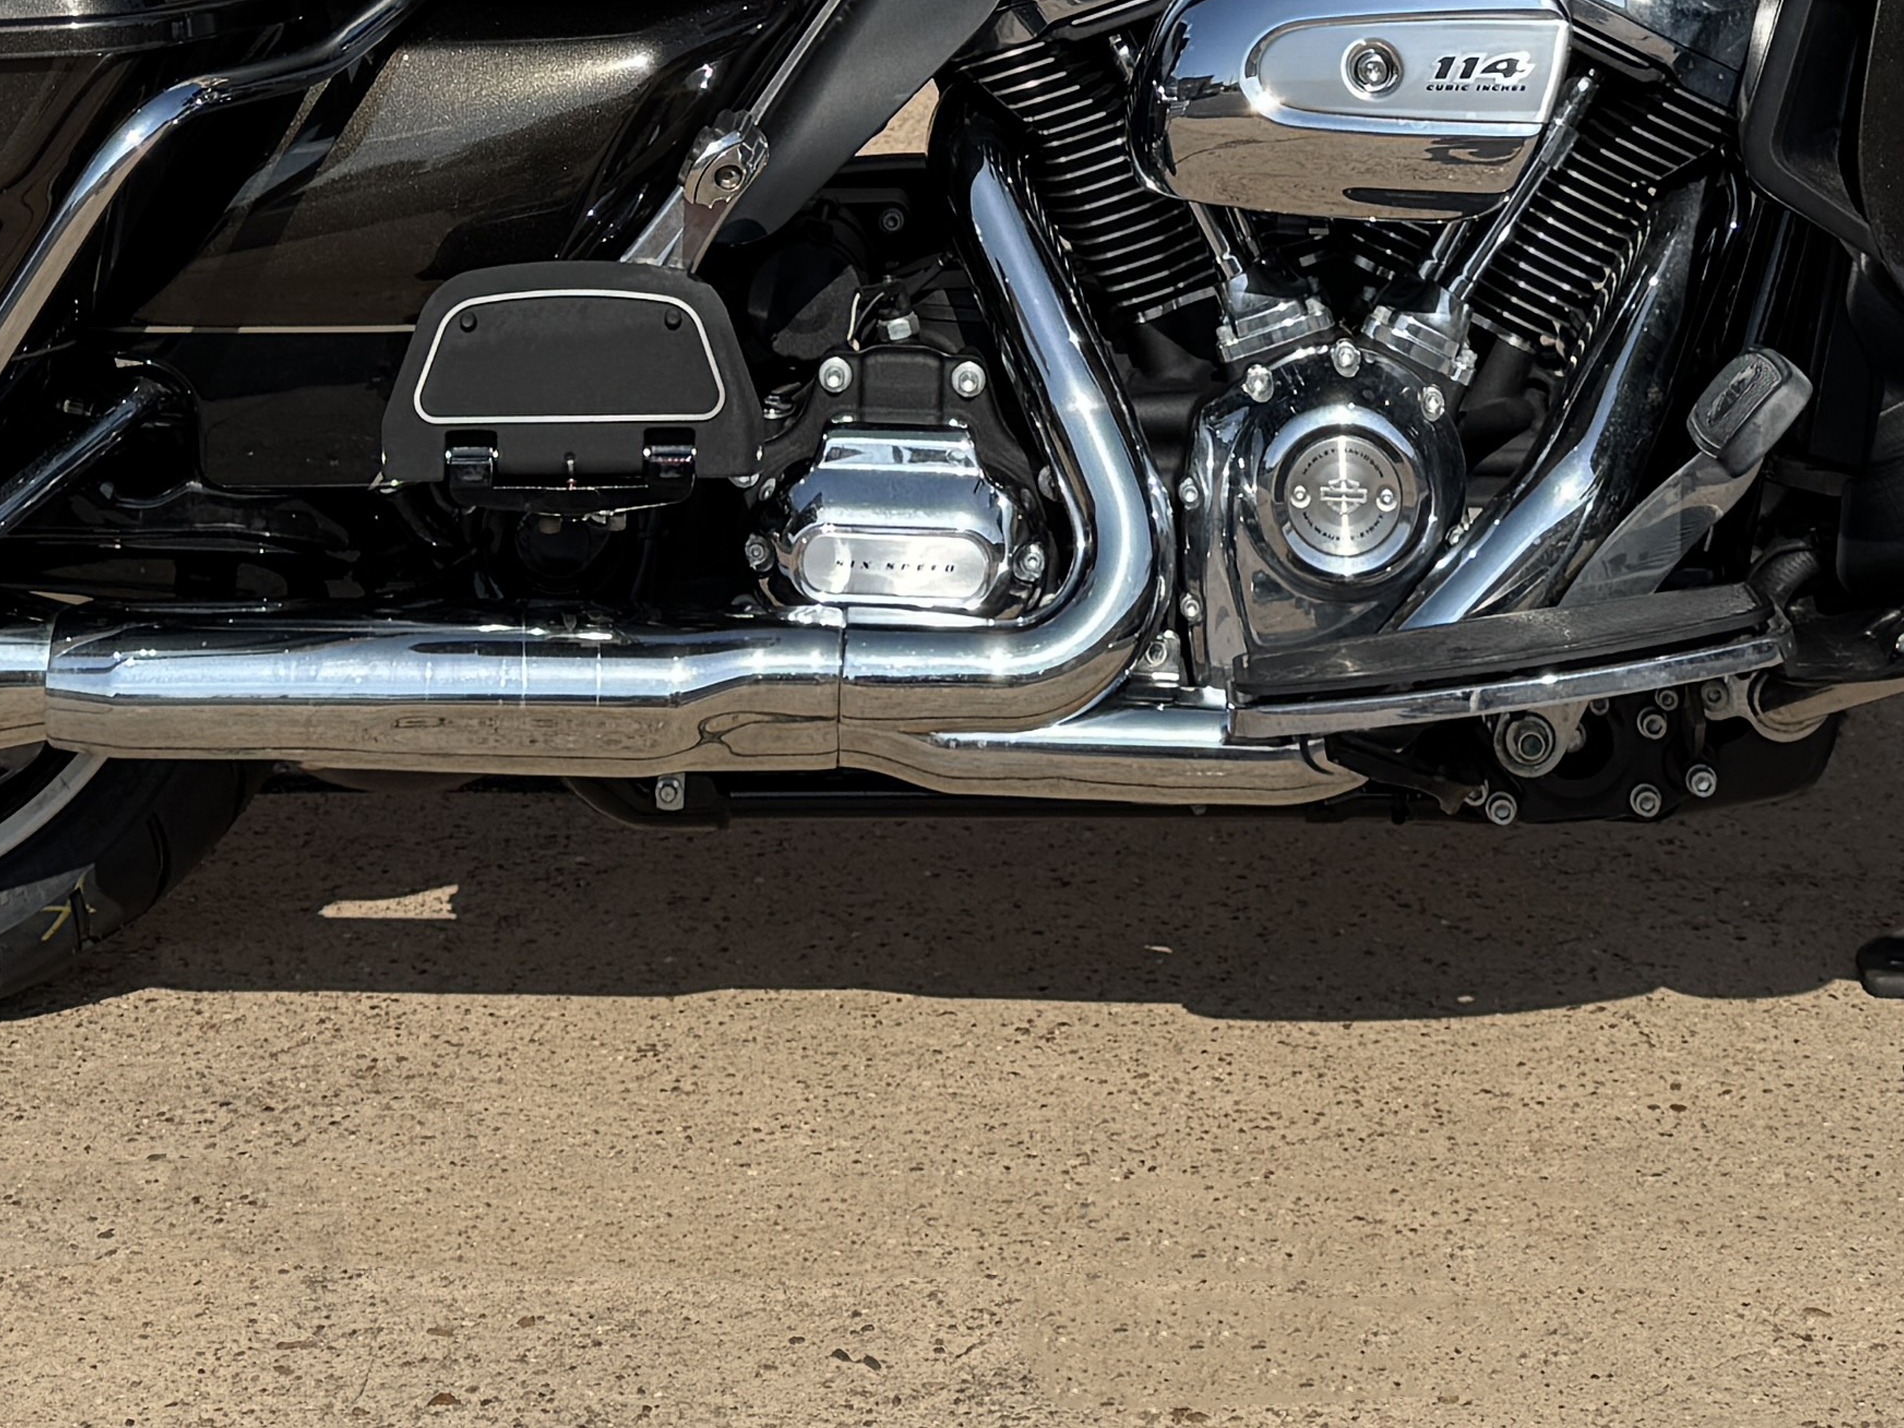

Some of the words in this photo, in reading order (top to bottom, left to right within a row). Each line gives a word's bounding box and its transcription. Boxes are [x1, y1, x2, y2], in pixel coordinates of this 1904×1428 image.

[1431, 52, 1532, 83] 114
[1426, 84, 1470, 92] CUBIC
[1476, 84, 1526, 92] INCHES
